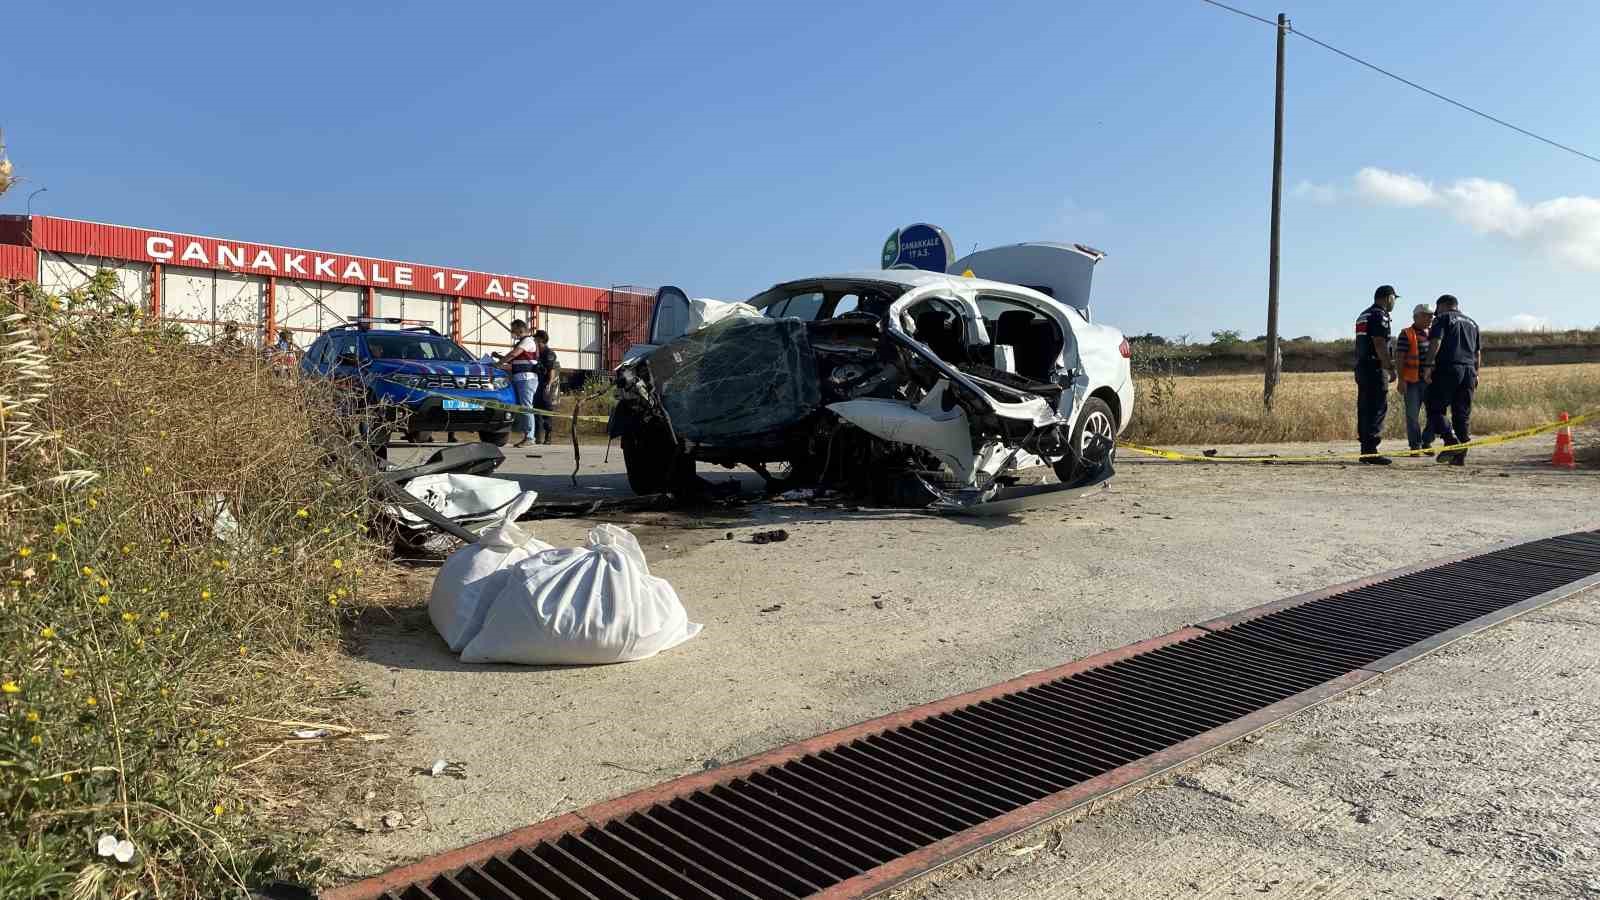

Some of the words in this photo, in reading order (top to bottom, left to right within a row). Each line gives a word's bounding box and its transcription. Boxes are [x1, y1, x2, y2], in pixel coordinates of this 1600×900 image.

[146, 236, 413, 285] ÇANAKKALE
[433, 272, 469, 291] 17
[485, 280, 535, 302] A.Ş.
